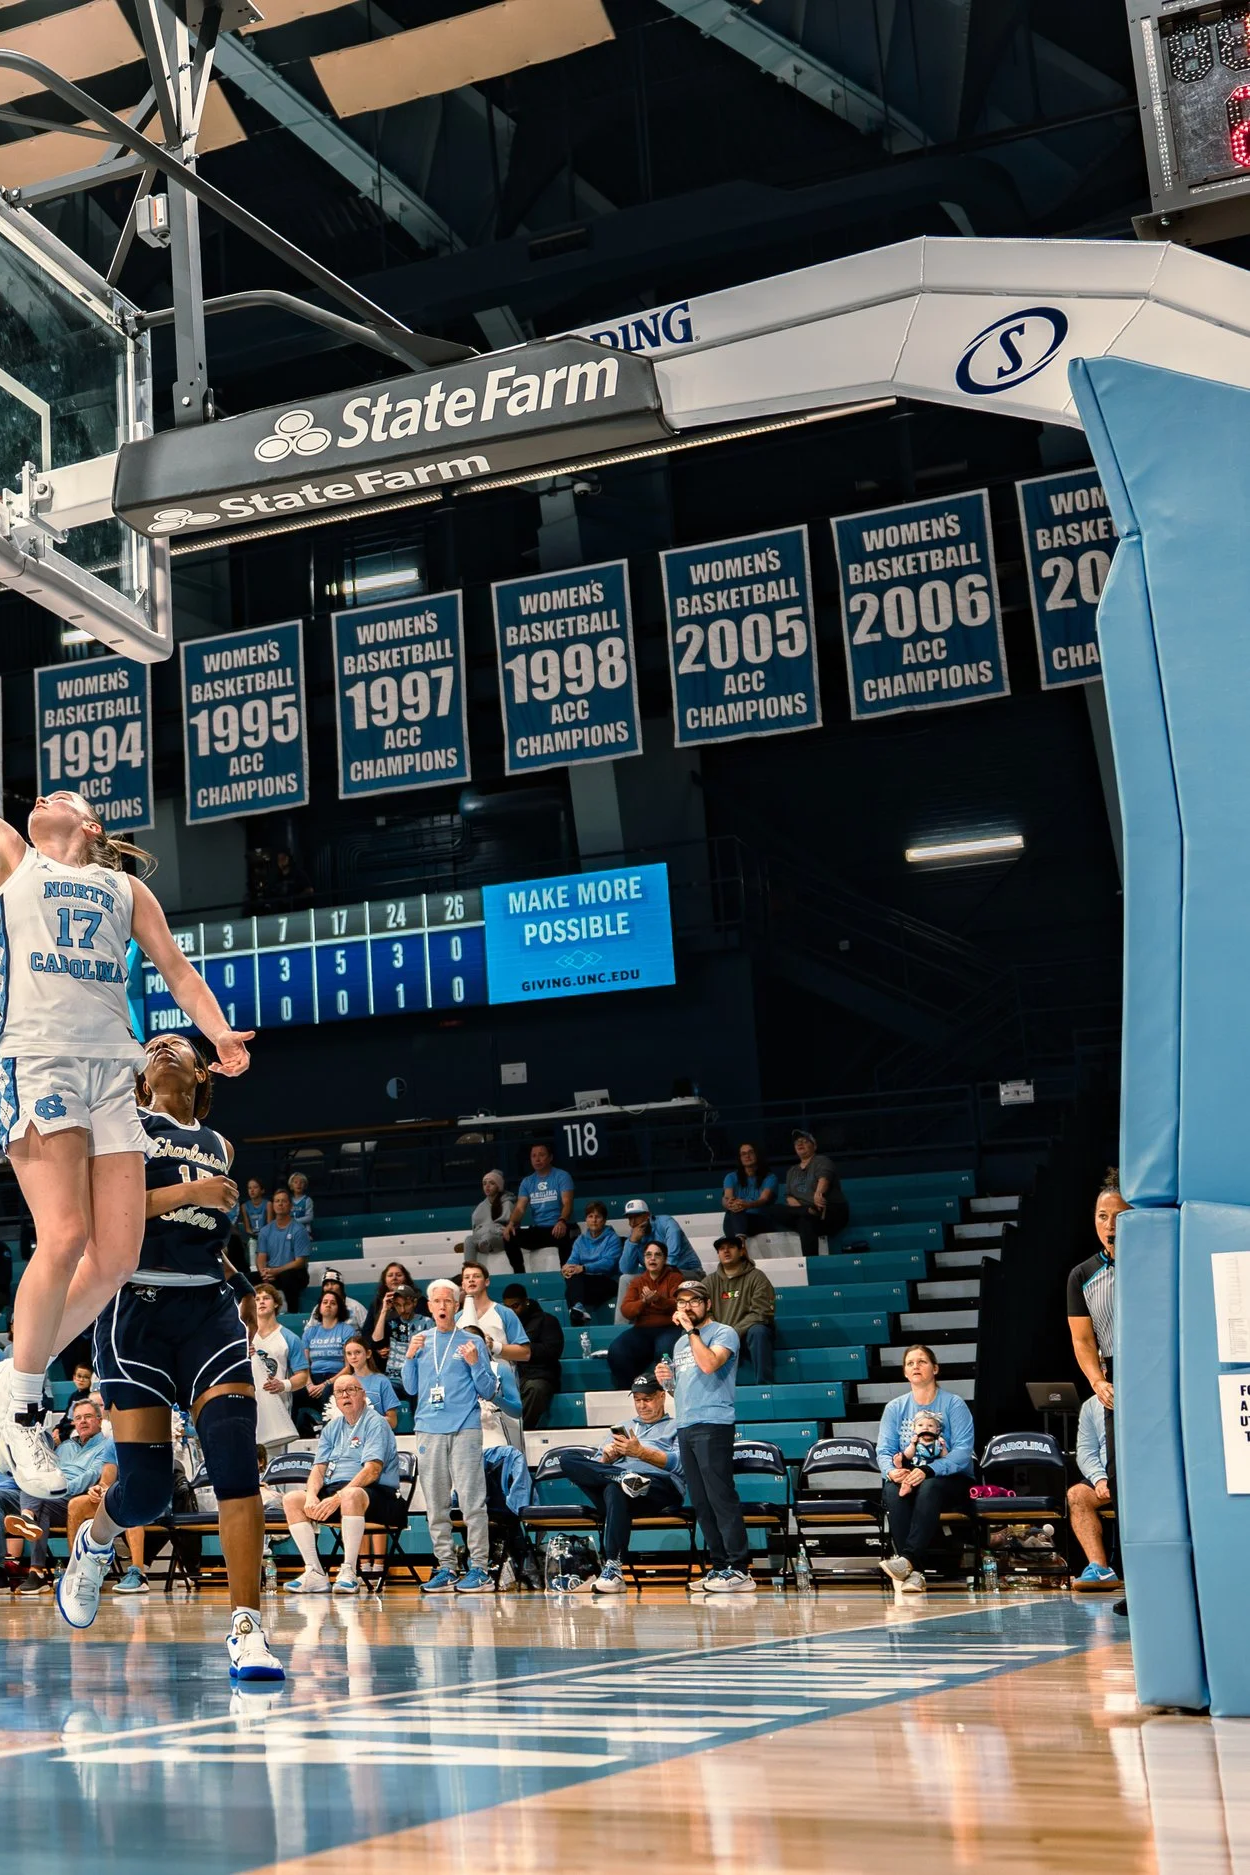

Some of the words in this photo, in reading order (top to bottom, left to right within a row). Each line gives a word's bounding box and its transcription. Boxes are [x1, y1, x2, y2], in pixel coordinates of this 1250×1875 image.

[862, 512, 960, 551] WOMEN'S
[689, 548, 781, 585] WOMEN'S
[849, 542, 981, 585] BASKETBALL
[519, 579, 604, 616] WOMEN'S
[676, 577, 800, 617] BASKETBALL
[850, 573, 990, 646] 2006
[356, 610, 438, 646] WOMEN'S
[506, 608, 620, 647] BASKETBALL
[675, 606, 808, 675] 2005
[203, 639, 280, 674] WOMEN'S
[343, 639, 454, 676] BASKETBALL
[902, 638, 947, 664] ACC
[57, 668, 129, 700] WOMEN'S
[191, 667, 294, 704] BASKETBALL
[505, 637, 627, 704] 1998
[724, 670, 765, 696] ACC
[863, 660, 993, 701] CHAMPIONS
[44, 696, 141, 729] BASKETBALL
[346, 666, 454, 730] 1997
[551, 699, 590, 725] ACC
[685, 692, 807, 729] CHAMPIONS
[189, 694, 300, 756] 1995
[384, 726, 422, 750] ACC
[516, 721, 629, 758] CHAMPIONS
[42, 721, 145, 780] 1994
[229, 752, 264, 776] ACC
[350, 748, 458, 782] CHAMPIONS
[79, 777, 111, 799] ACC
[196, 772, 298, 808] CHAMPIONS
[44, 881, 115, 914] NORTH
[508, 886, 569, 914] MAKE
[577, 876, 642, 905] MORE
[57, 907, 103, 949] 17
[223, 924, 233, 949] 3
[278, 918, 288, 942] 7
[331, 909, 348, 935] 17
[386, 902, 407, 928] 24
[444, 895, 464, 921] 26
[524, 912, 630, 946] POSSIBLE
[30, 952, 125, 983] CAROLINA
[224, 963, 235, 988] 0
[279, 956, 291, 982] 3
[336, 950, 346, 975] 5
[392, 943, 403, 968] 3
[451, 936, 462, 961] 0
[522, 969, 640, 992] GIVING.UNC.EDU
[150, 1009, 192, 1030] FOULS
[281, 996, 292, 1021] 0
[337, 989, 348, 1015] 0
[396, 983, 405, 1008] 1
[452, 976, 464, 1002] 0
[563, 1122, 598, 1157] 118
[1241, 1401, 1248, 1411] A
[814, 1446, 869, 1460] CAROLINA
[992, 1441, 1051, 1455] CAROLINA
